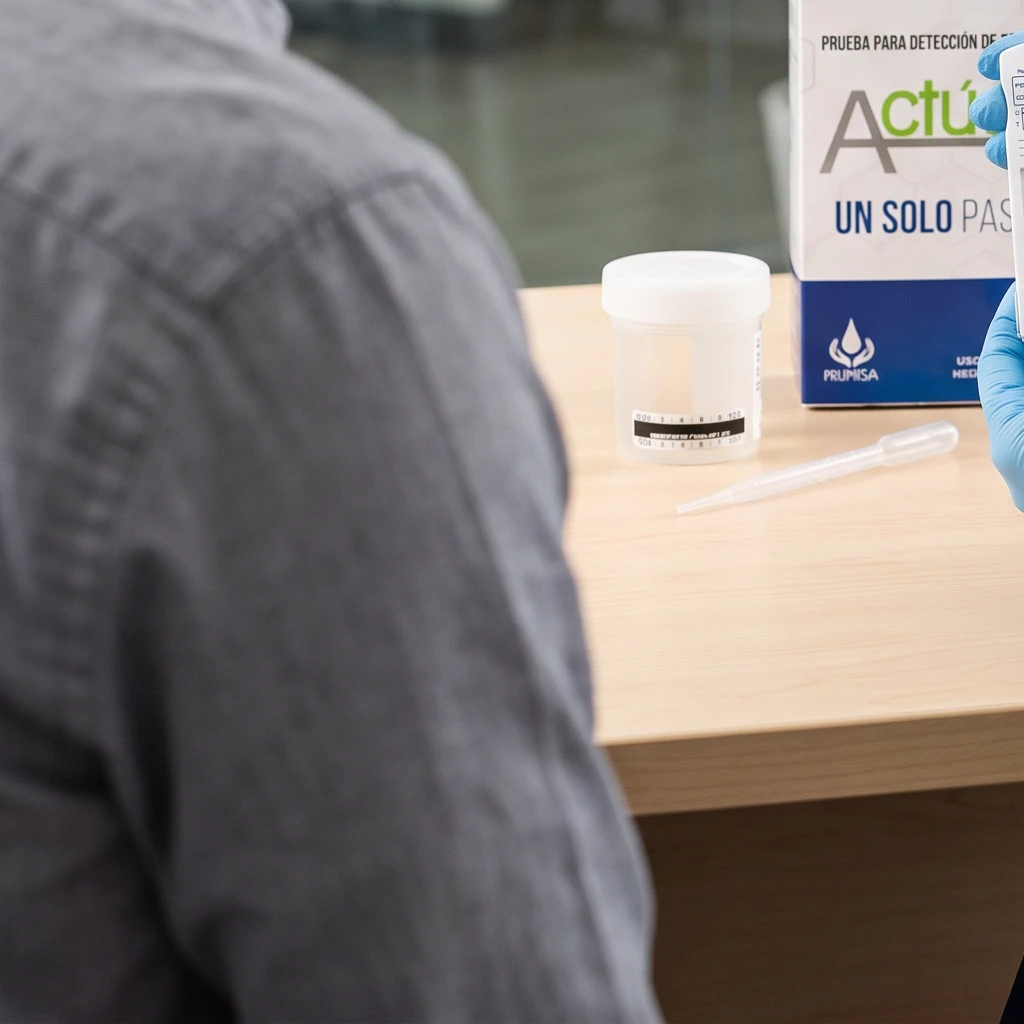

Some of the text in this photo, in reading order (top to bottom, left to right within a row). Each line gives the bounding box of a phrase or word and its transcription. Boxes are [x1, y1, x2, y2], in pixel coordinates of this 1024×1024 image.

[821, 35, 870, 51] PRUEBA
[873, 34, 906, 50] PARA
[910, 31, 977, 50] DETECCIÓN
[819, 79, 998, 174] Actú
[835, 198, 1013, 234] UN SOLO PAS
